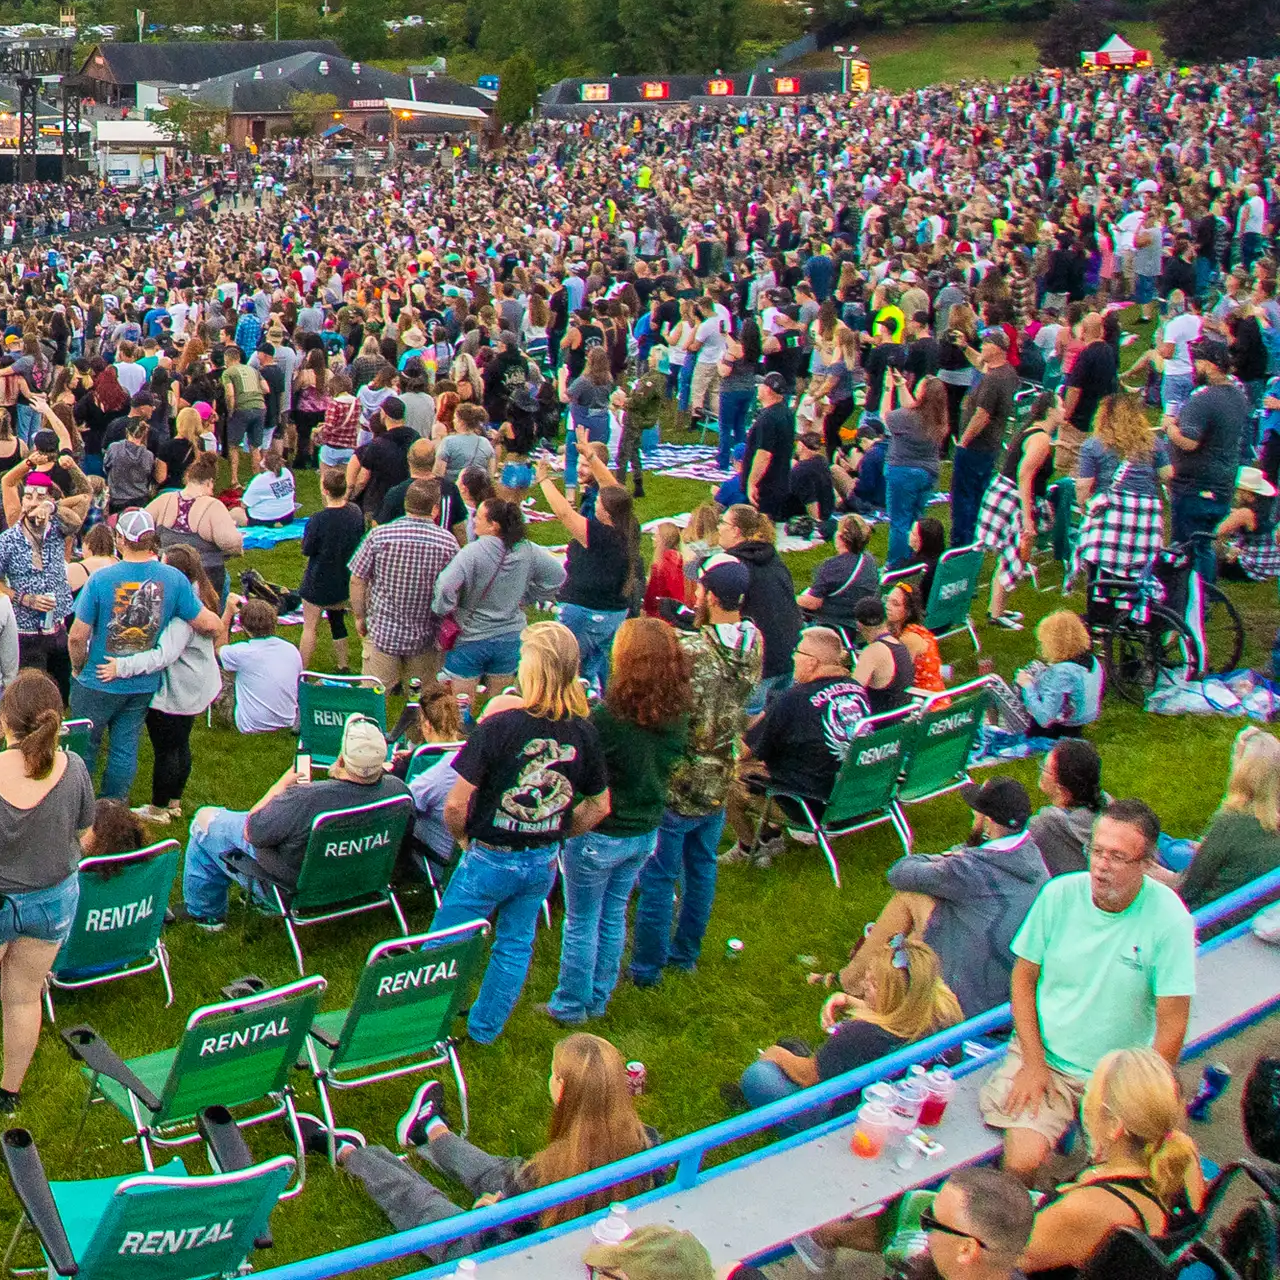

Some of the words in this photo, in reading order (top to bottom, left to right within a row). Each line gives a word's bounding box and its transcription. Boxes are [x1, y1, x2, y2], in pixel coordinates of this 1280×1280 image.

[313, 710, 345, 727] REN
[928, 709, 974, 736] RENTAL
[856, 740, 900, 766] RENTAL
[324, 830, 390, 857] RENTAL
[85, 895, 153, 932] RENTAL
[377, 959, 458, 997] RENTAL
[199, 1017, 290, 1057] RENTAL
[118, 1220, 234, 1255] RENTAL
